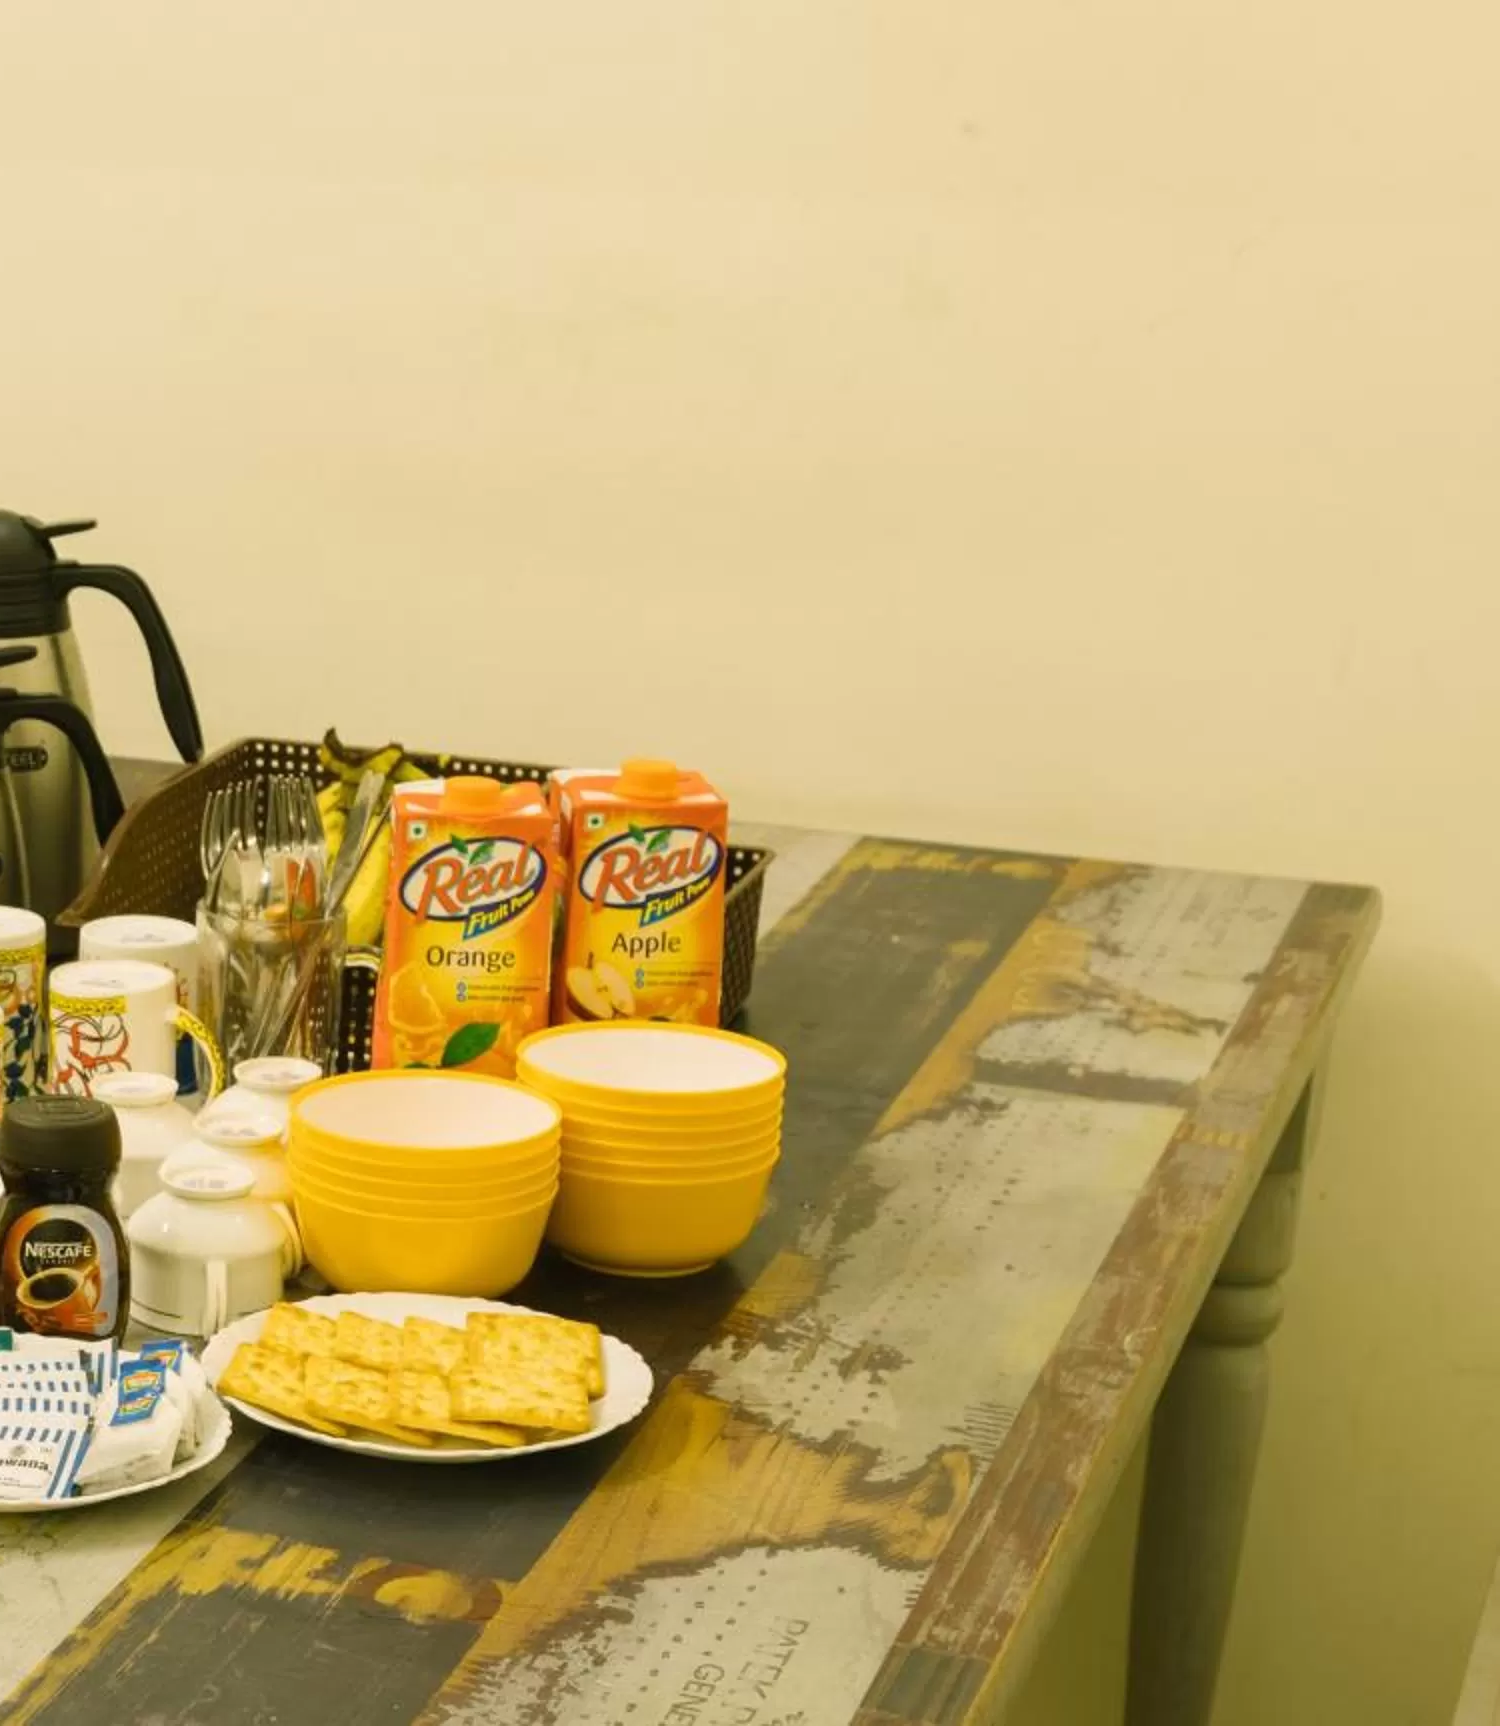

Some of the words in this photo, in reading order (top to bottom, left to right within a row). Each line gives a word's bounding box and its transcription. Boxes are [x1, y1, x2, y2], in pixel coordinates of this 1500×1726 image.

[414, 845, 534, 925] Real
[592, 830, 709, 913] Real
[467, 903, 509, 936] Fruit
[643, 890, 685, 923] Fruit
[425, 945, 516, 973] Orange
[611, 931, 682, 959] Apple
